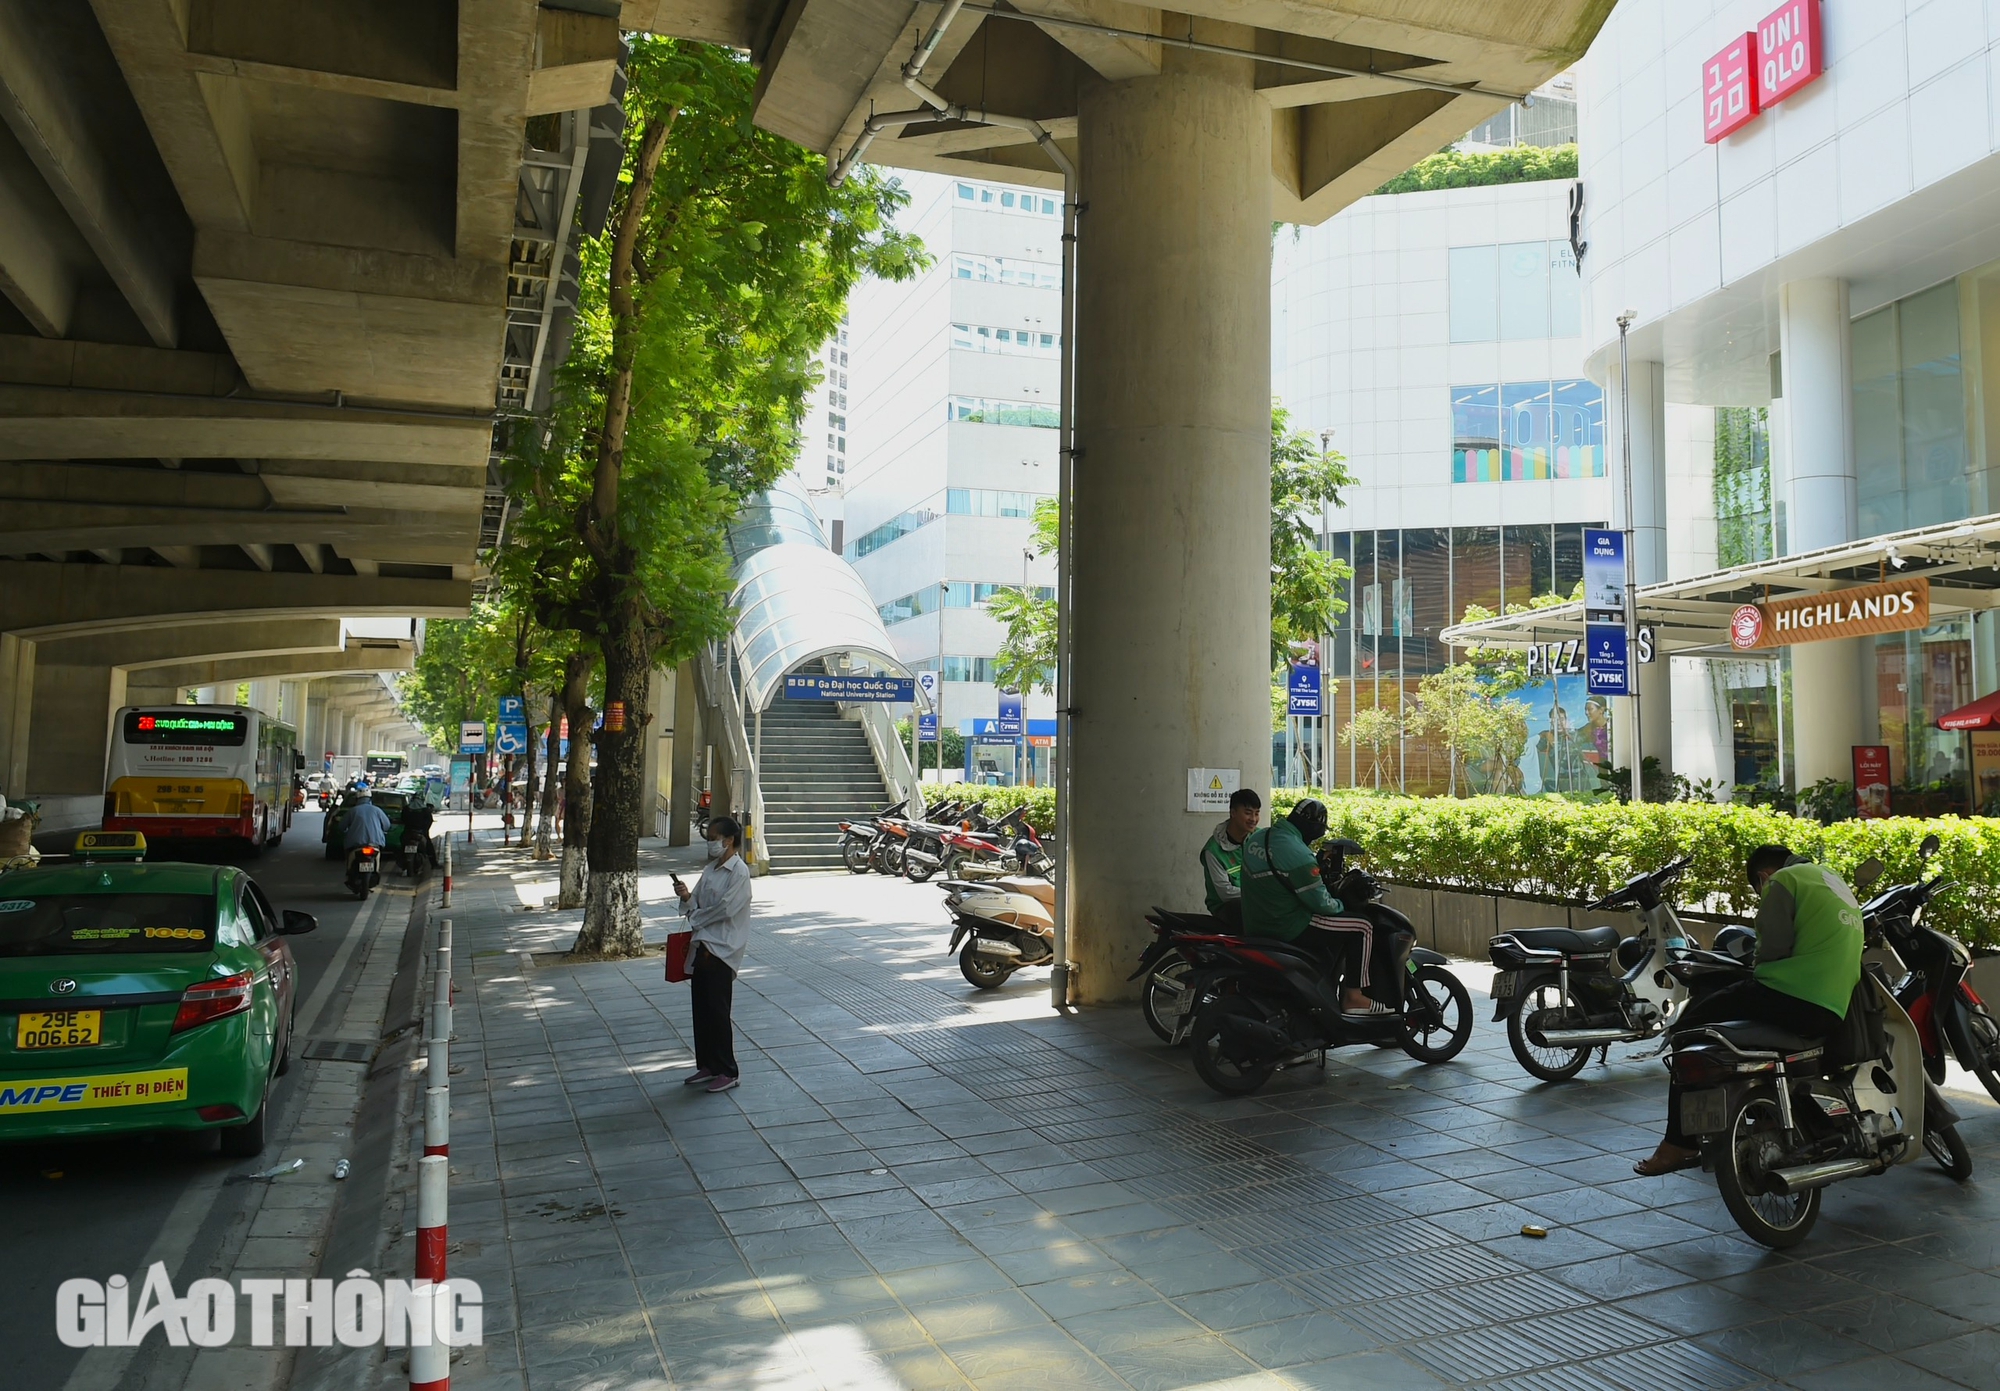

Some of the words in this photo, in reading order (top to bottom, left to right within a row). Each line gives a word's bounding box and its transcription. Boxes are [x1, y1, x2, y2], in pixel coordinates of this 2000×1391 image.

[1763, 5, 1799, 55] UNI
[1764, 41, 1804, 92] QLO
[1598, 537, 1610, 545] GIA
[1594, 548, 1614, 556] DỤNG
[1732, 608, 1760, 626] HIGHLANDS
[1775, 591, 1915, 632] HIGHLANDS
[1735, 635, 1756, 645] COFFEE
[1528, 639, 1586, 676] PIZZ
[819, 680, 829, 688] Ga
[832, 680, 844, 690] Đại
[847, 681, 860, 690] học
[863, 680, 883, 690] Quốc
[885, 681, 898, 690] Gia
[1597, 673, 1622, 683] JYSK
[846, 691, 875, 699] University
[506, 699, 518, 713] P
[145, 927, 206, 940] 1055
[42, 1012, 78, 1029] 29E
[25, 1028, 91, 1047] 006.62
[92, 1081, 131, 1098] THIẾT
[136, 1083, 149, 1097] BỊ
[153, 1078, 184, 1095] ĐIỆN
